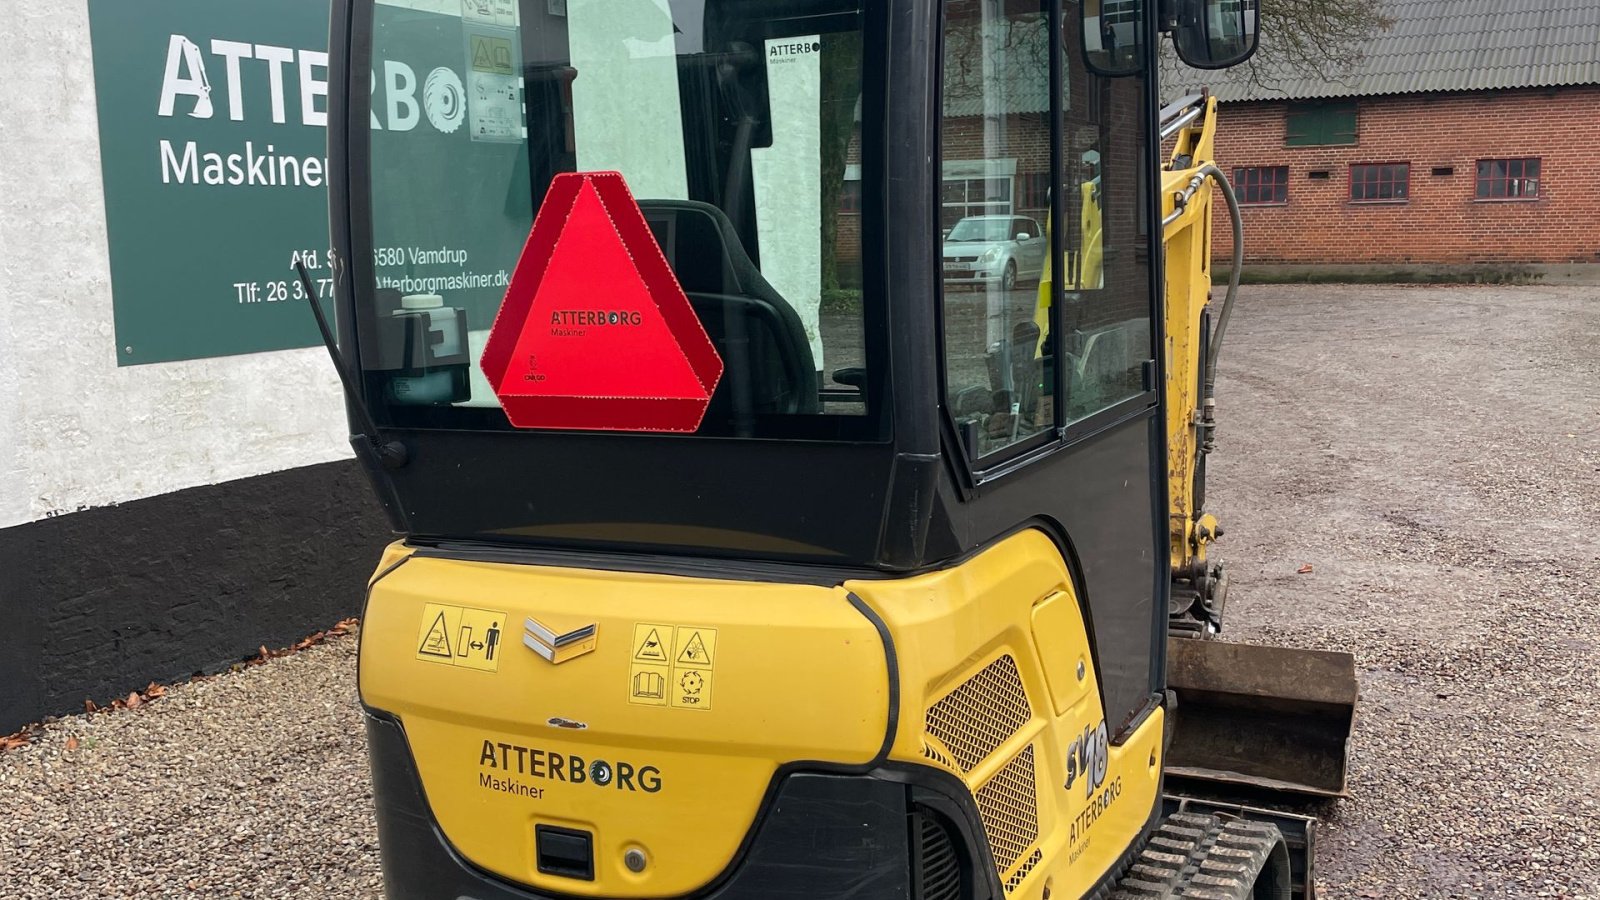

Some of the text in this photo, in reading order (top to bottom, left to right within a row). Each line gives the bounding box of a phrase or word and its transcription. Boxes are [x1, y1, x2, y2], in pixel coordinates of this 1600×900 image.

[770, 42, 830, 56] ATTERBO
[289, 249, 322, 271] Afd.
[408, 246, 468, 269] Vamdrup
[233, 282, 262, 304] Tlf:
[265, 281, 288, 302] 26
[552, 311, 641, 325] ATTERBORG
[551, 328, 586, 337] Maskiner
[682, 695, 700, 705] STOP
[479, 739, 663, 794] ATTERBORG
[1064, 719, 1109, 800] SV18
[479, 772, 545, 800] Maskiner
[1069, 775, 1122, 848] ATTERBORG
[1068, 837, 1091, 866] Maskiner
